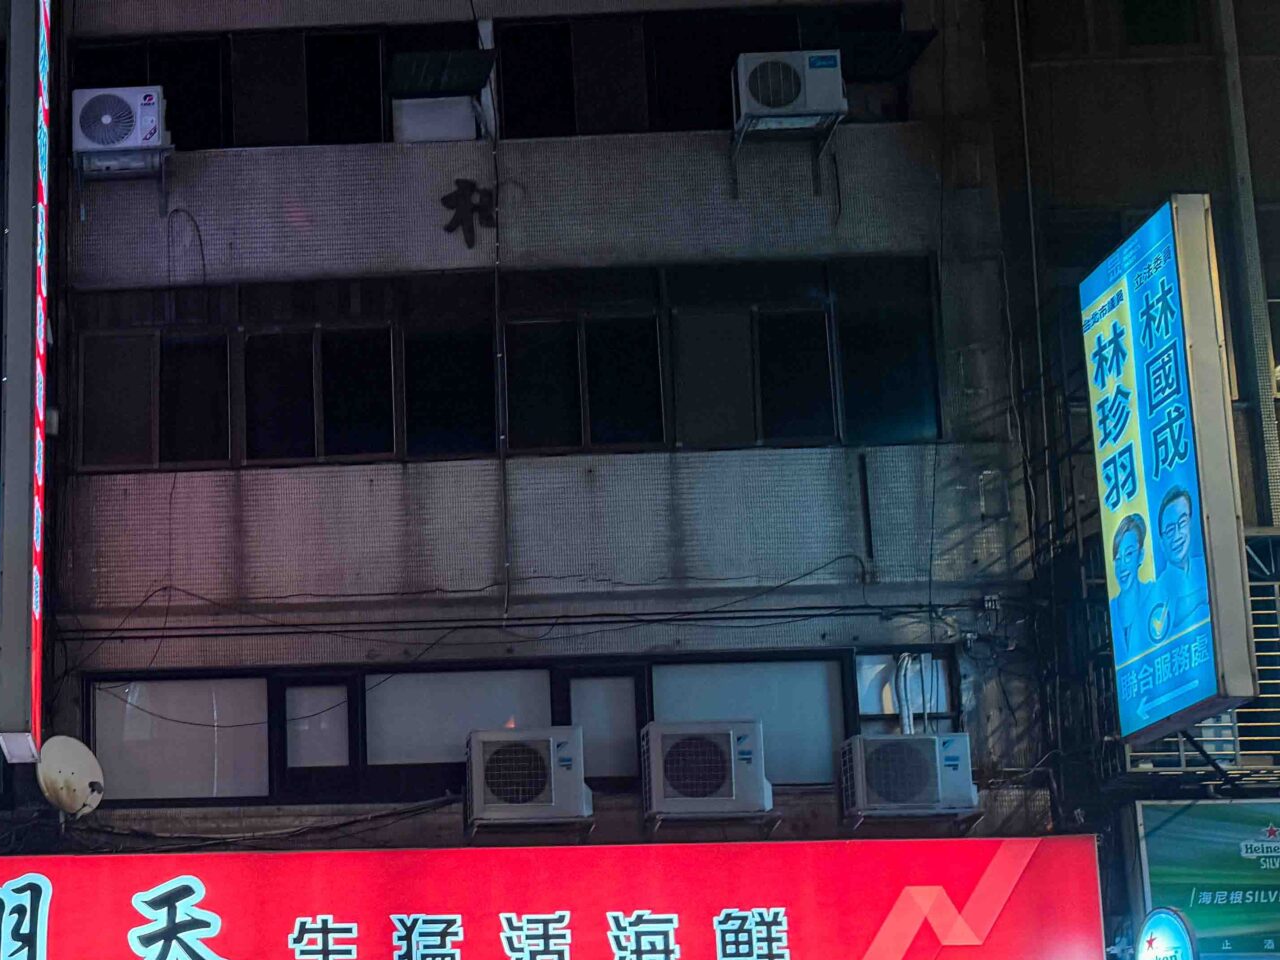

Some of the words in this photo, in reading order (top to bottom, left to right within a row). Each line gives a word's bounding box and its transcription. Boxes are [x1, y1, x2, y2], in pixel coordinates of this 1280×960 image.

[1090, 321, 1138, 511] 林珍羽
[1139, 277, 1190, 479] 林國成
[1198, 890, 1280, 905] 海尼根SILV
